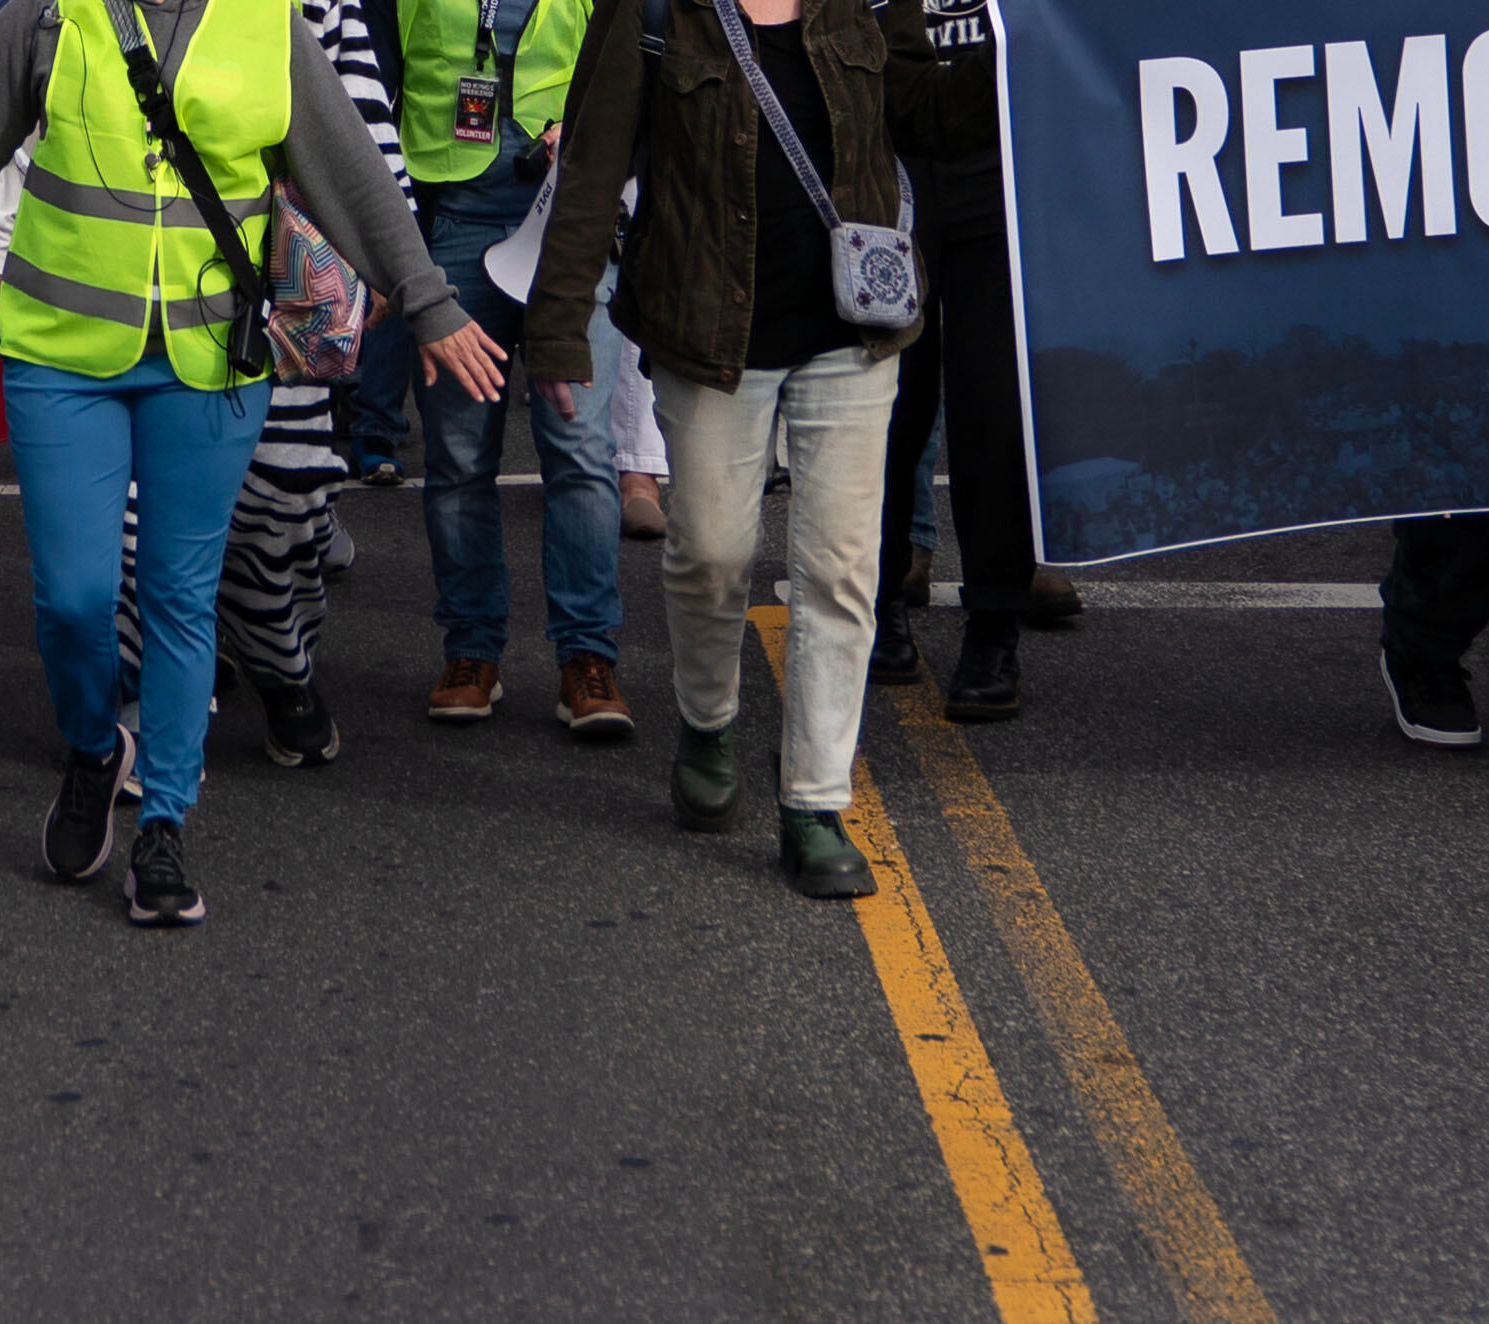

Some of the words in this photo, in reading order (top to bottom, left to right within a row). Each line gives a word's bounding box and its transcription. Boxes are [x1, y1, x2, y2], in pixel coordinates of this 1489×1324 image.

[460, 89, 494, 98] WEEKEND
[455, 128, 491, 141] VOLUNTEER
[535, 182, 553, 216] PYLE
